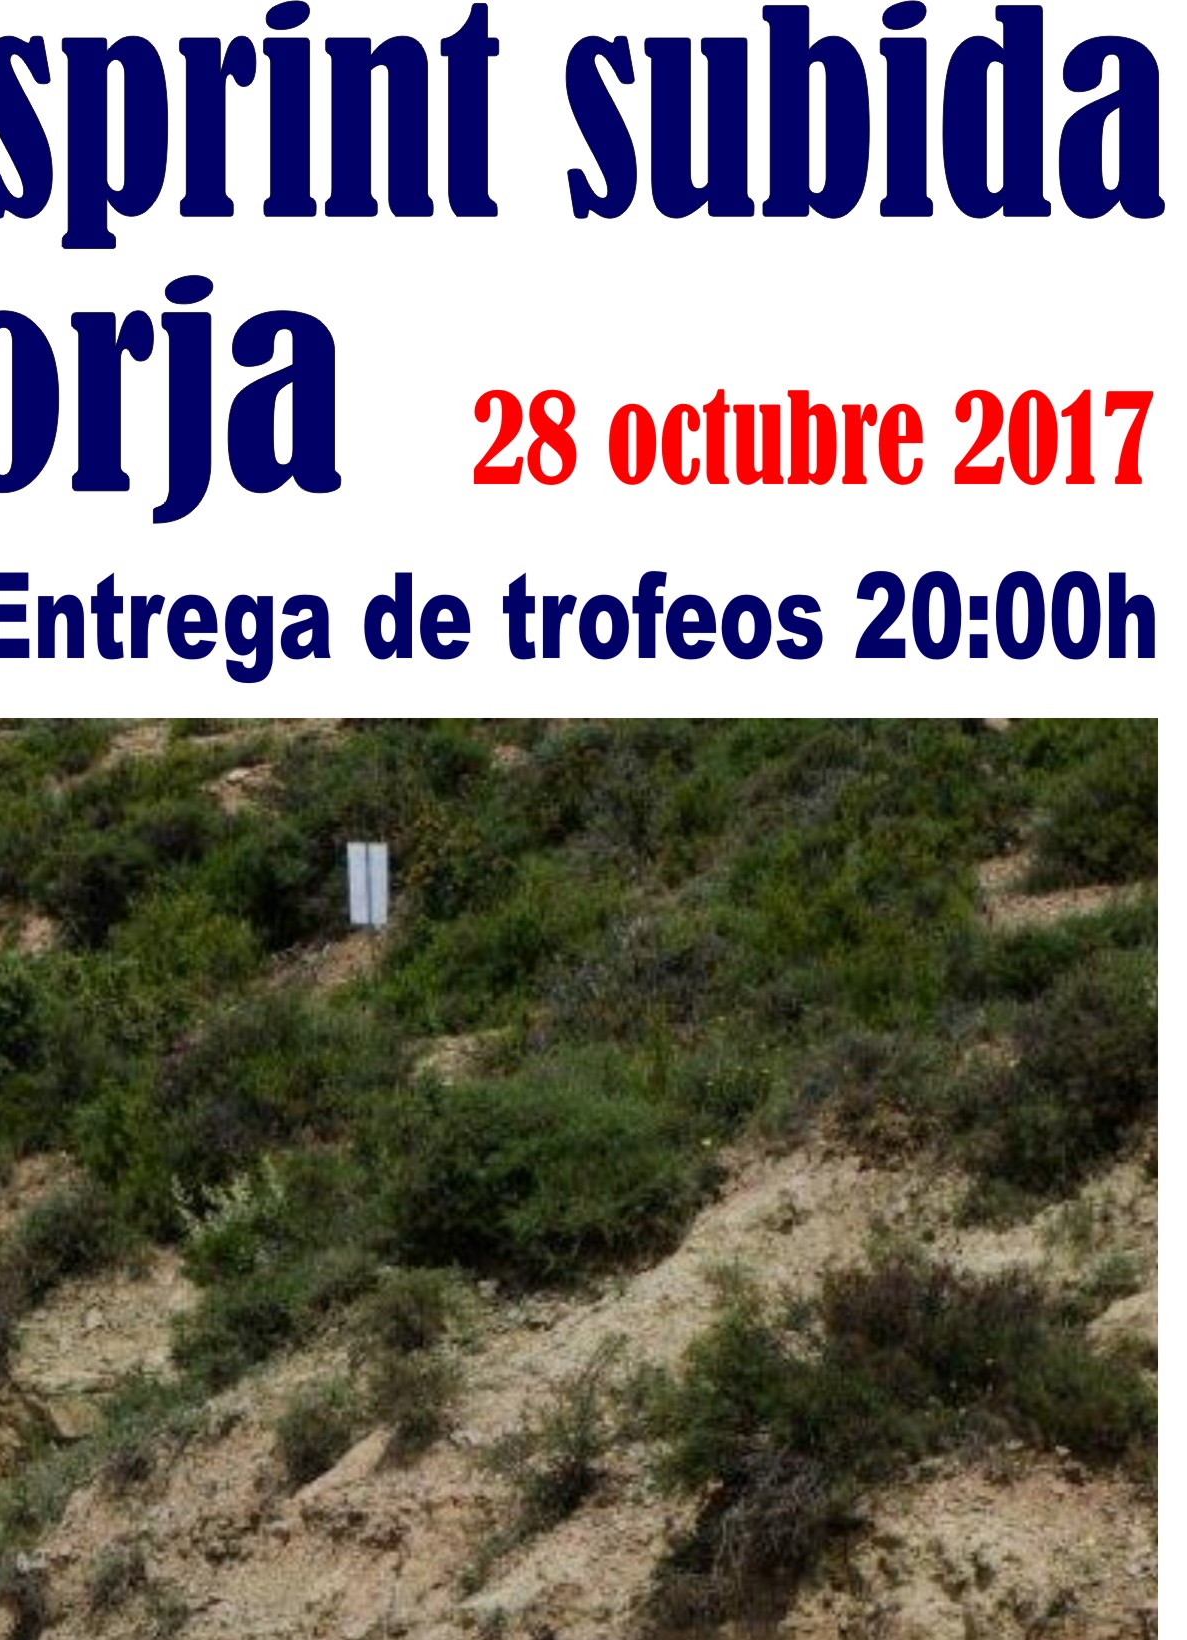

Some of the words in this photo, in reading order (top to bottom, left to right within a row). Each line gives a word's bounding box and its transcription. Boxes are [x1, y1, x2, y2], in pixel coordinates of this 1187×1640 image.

[566, 1, 1165, 219] subida
[474, 390, 576, 485] 28
[609, 389, 923, 485] octubre
[955, 390, 1153, 485] 2017
[364, 573, 470, 659] de
[503, 571, 822, 659] trofeos
[856, 571, 1155, 659] 20:00h
